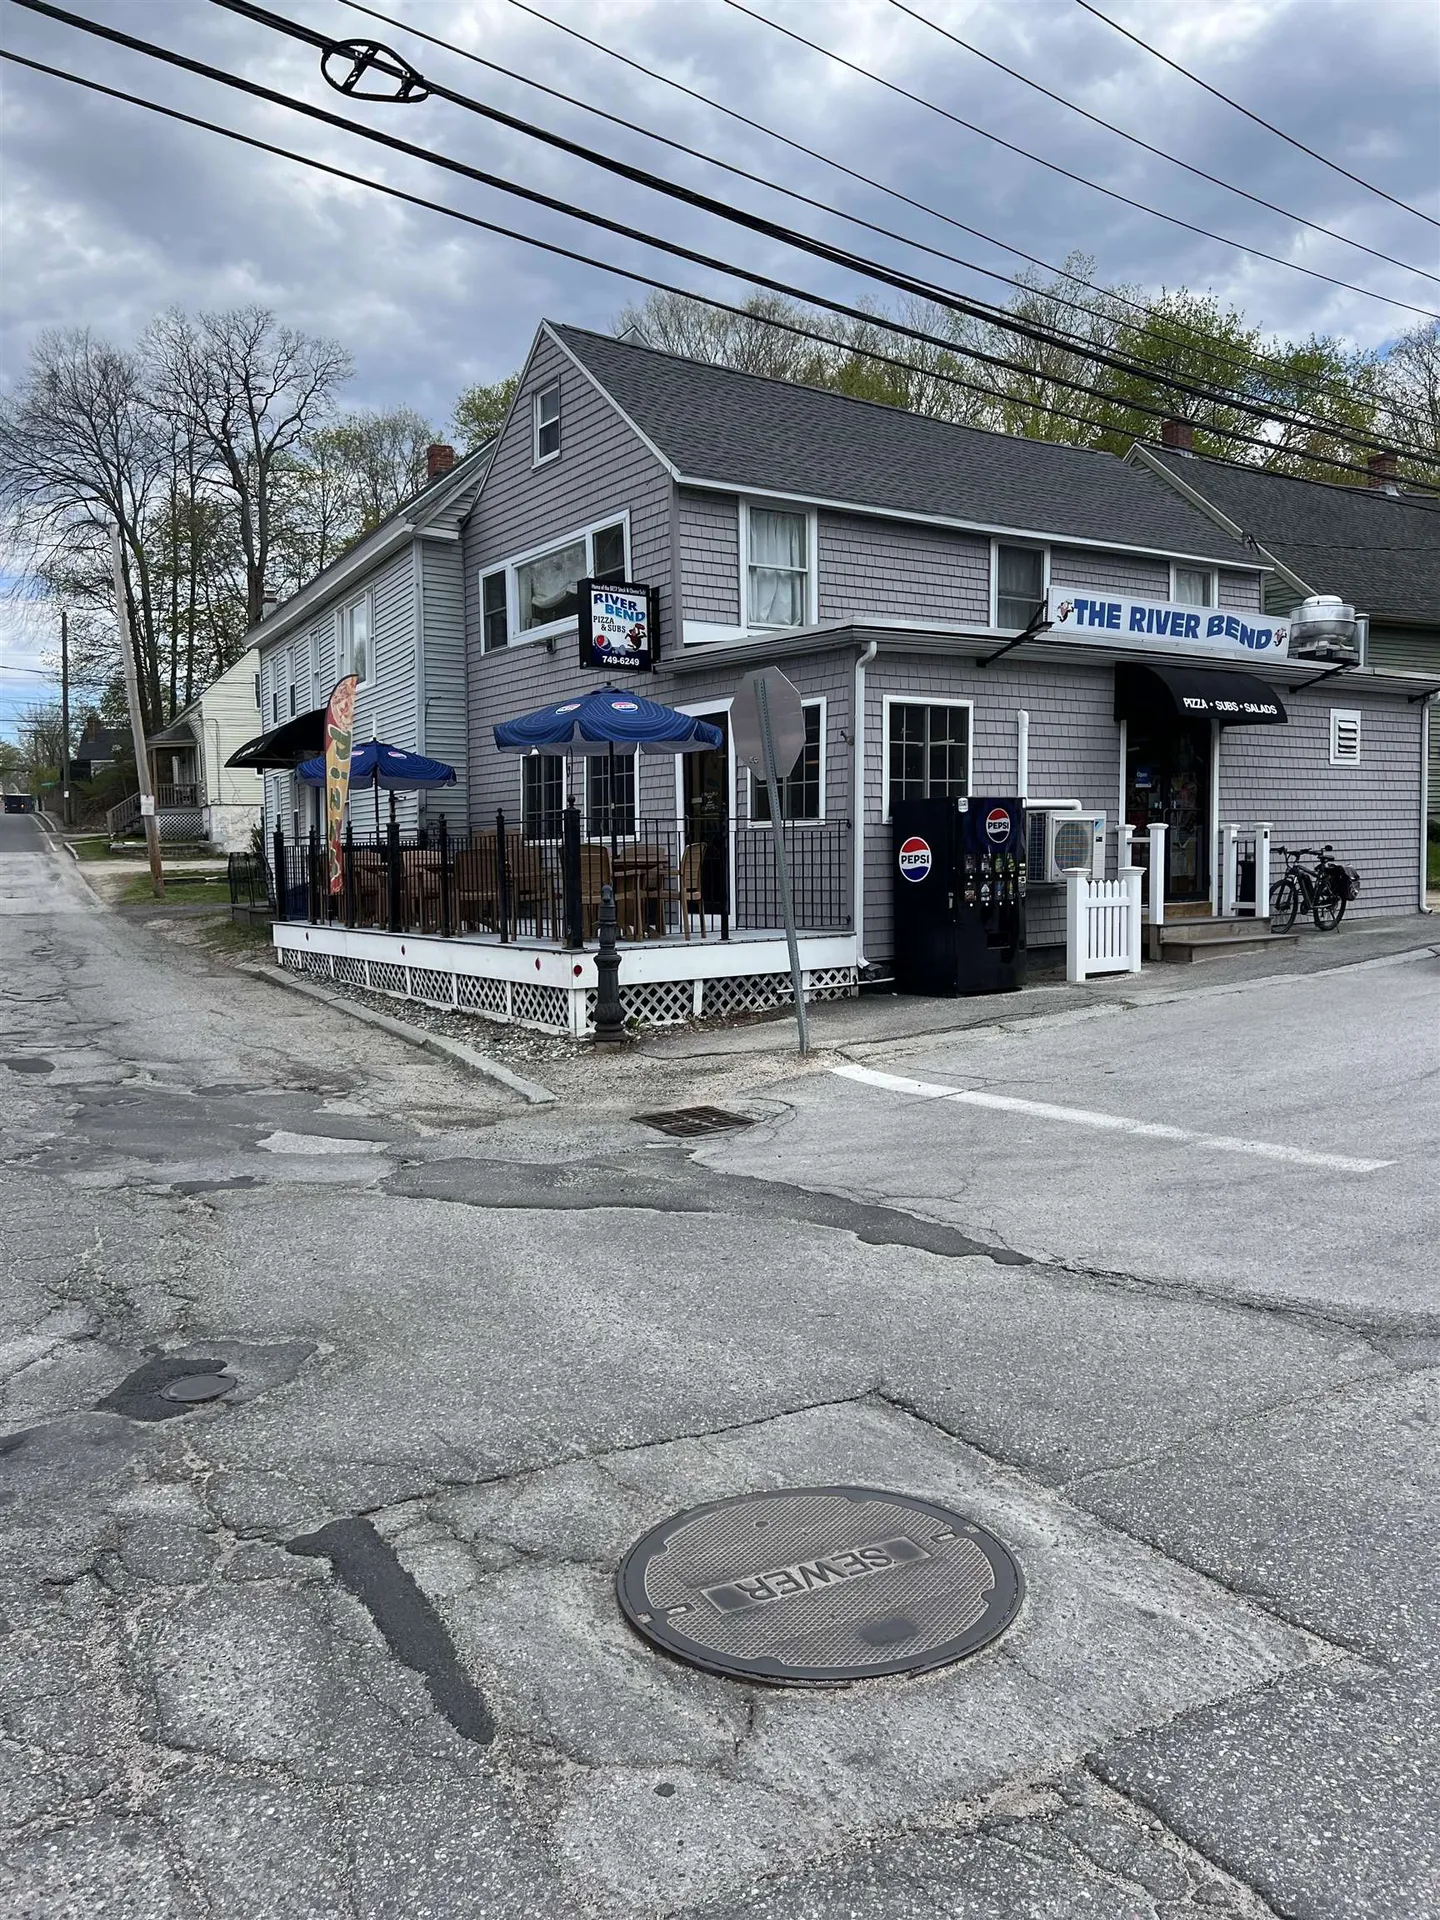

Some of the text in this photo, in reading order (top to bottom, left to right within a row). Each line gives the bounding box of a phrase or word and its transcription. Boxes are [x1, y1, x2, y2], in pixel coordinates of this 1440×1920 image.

[594, 593, 638, 611] RIVER
[604, 604, 645, 622] BEND
[593, 616, 614, 624] PIZZA
[1074, 598, 1273, 650] THE RIVER BEND
[607, 625, 626, 633] SUBS
[602, 656, 639, 666] 749-6249
[1183, 698, 1277, 714] PIZZA SUBS SALADS
[987, 821, 1009, 830] PEPSI
[901, 854, 930, 864] PEPSI
[733, 1546, 896, 1602] SEWER
